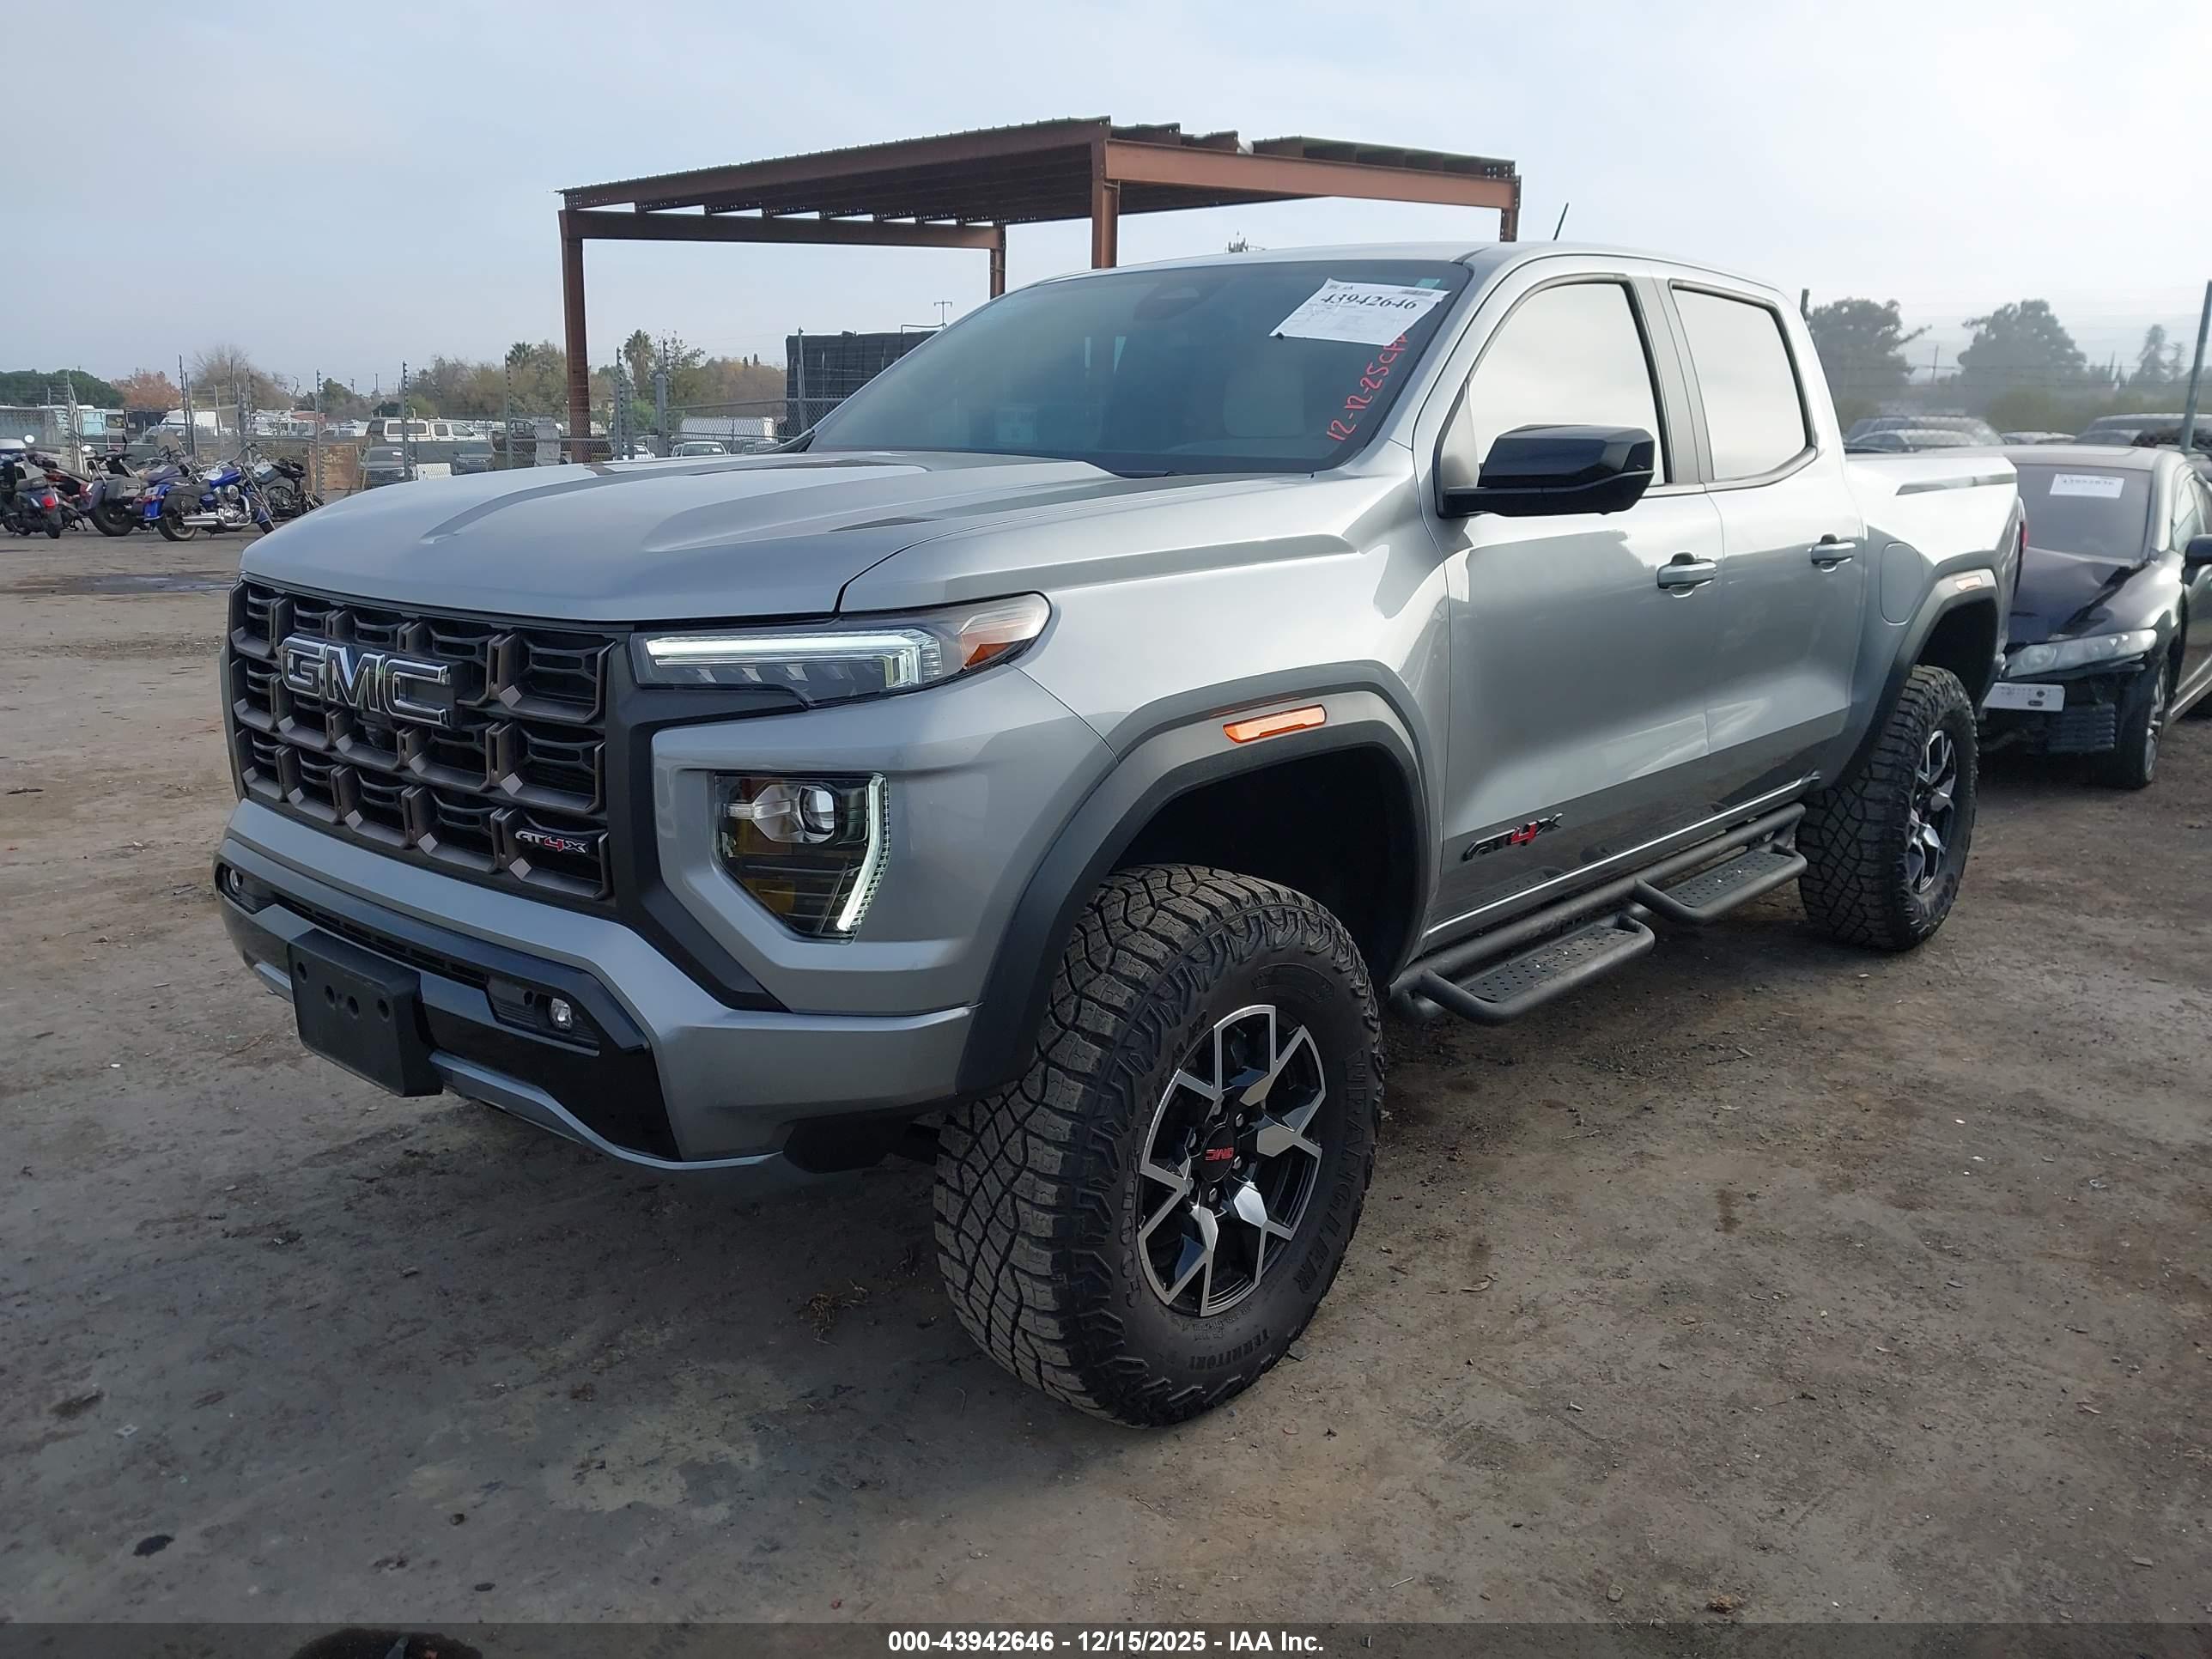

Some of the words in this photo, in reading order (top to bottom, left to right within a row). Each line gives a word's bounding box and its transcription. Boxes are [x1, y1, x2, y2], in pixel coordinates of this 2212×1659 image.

[1321, 293, 1417, 311] 43942646
[282, 634, 451, 727] GMC
[515, 830, 587, 854] AT4X
[1204, 1147, 1235, 1161] GMC
